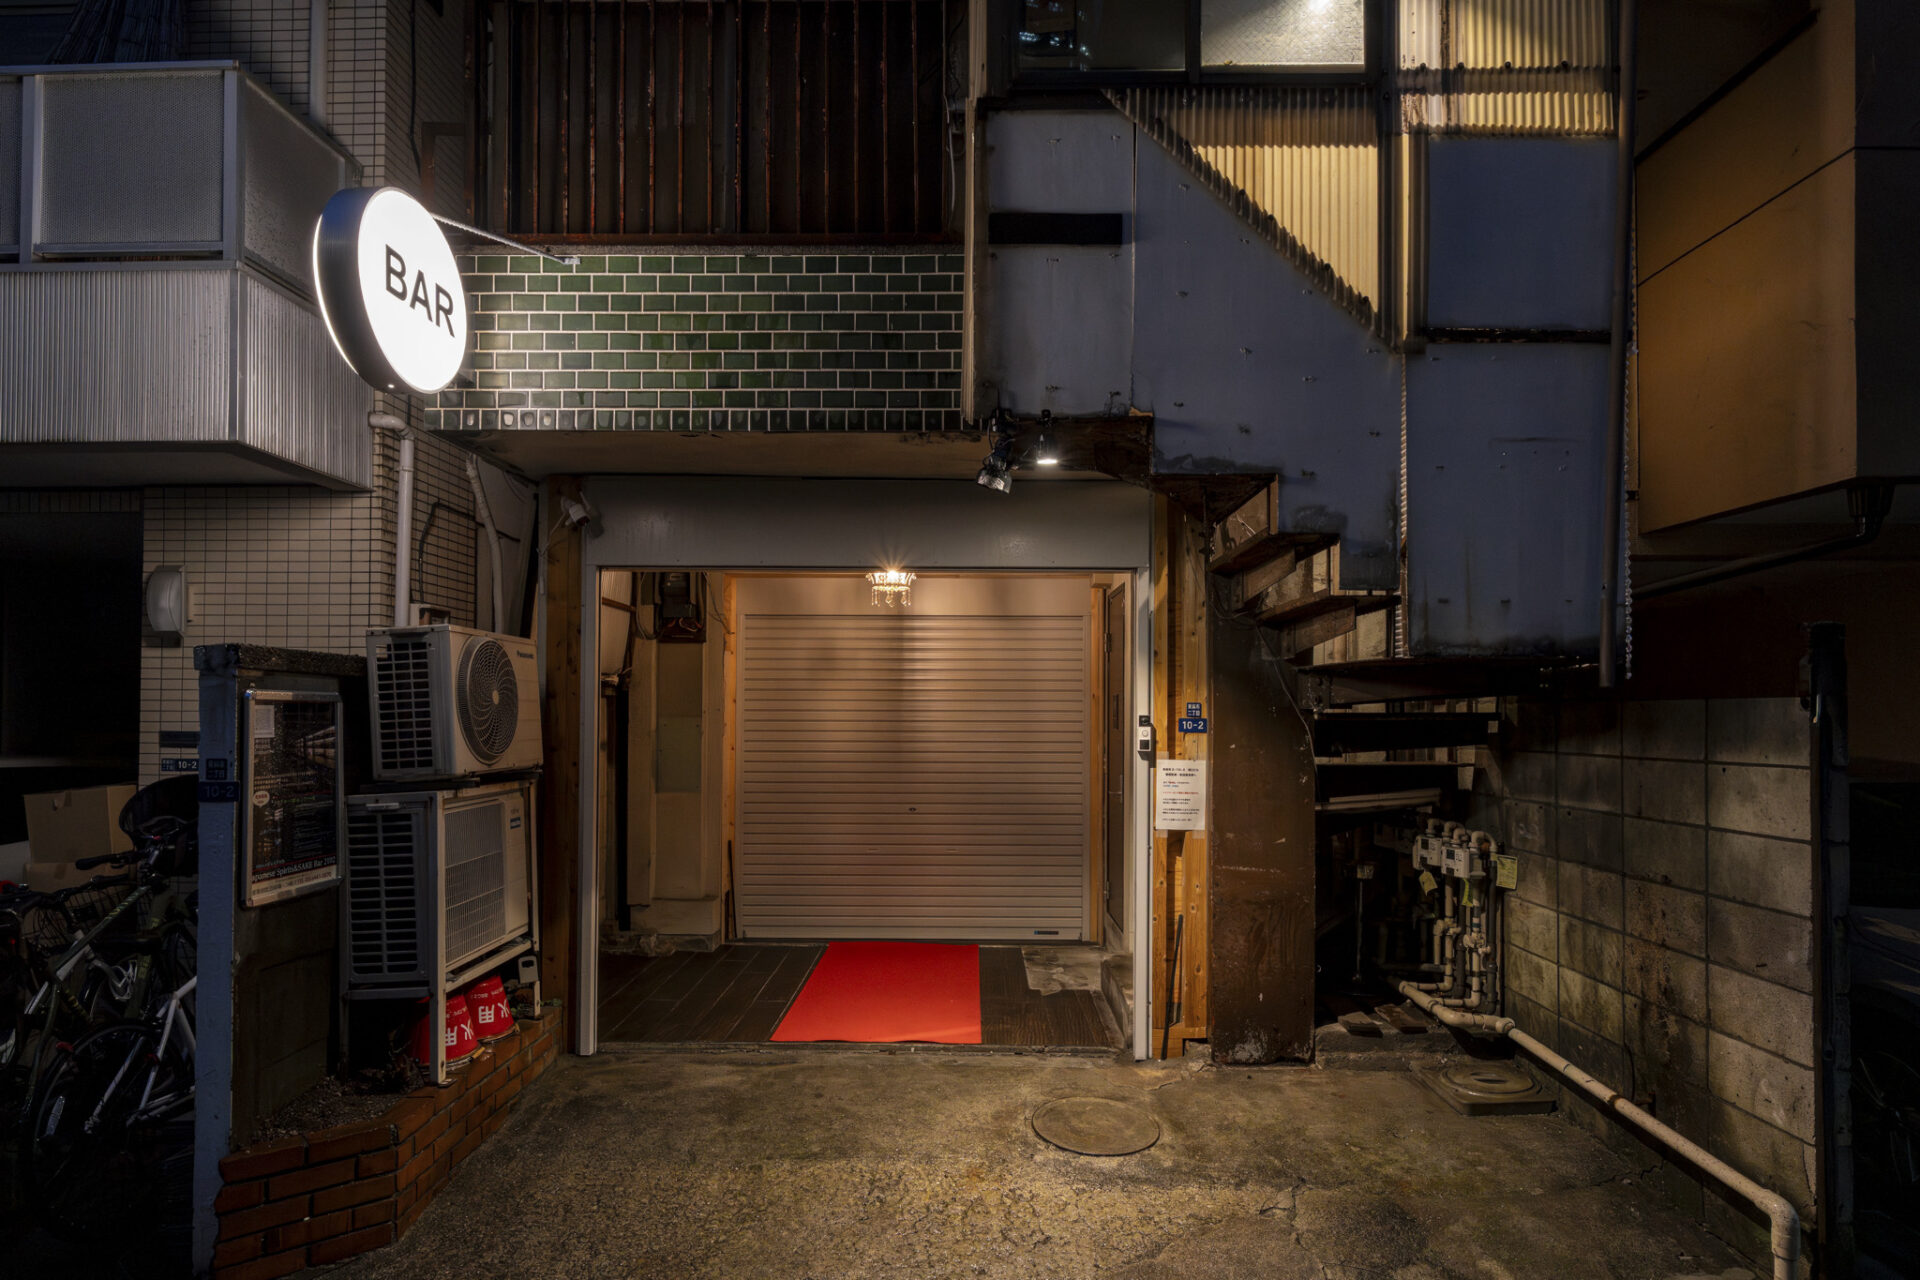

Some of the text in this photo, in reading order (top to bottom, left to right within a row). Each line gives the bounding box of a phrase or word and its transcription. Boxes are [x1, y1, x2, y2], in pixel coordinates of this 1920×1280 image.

[385, 243, 455, 338] BAR
[1182, 721, 1204, 730] 10-2
[178, 761, 197, 769] 10-2
[204, 785, 234, 798] 10-2
